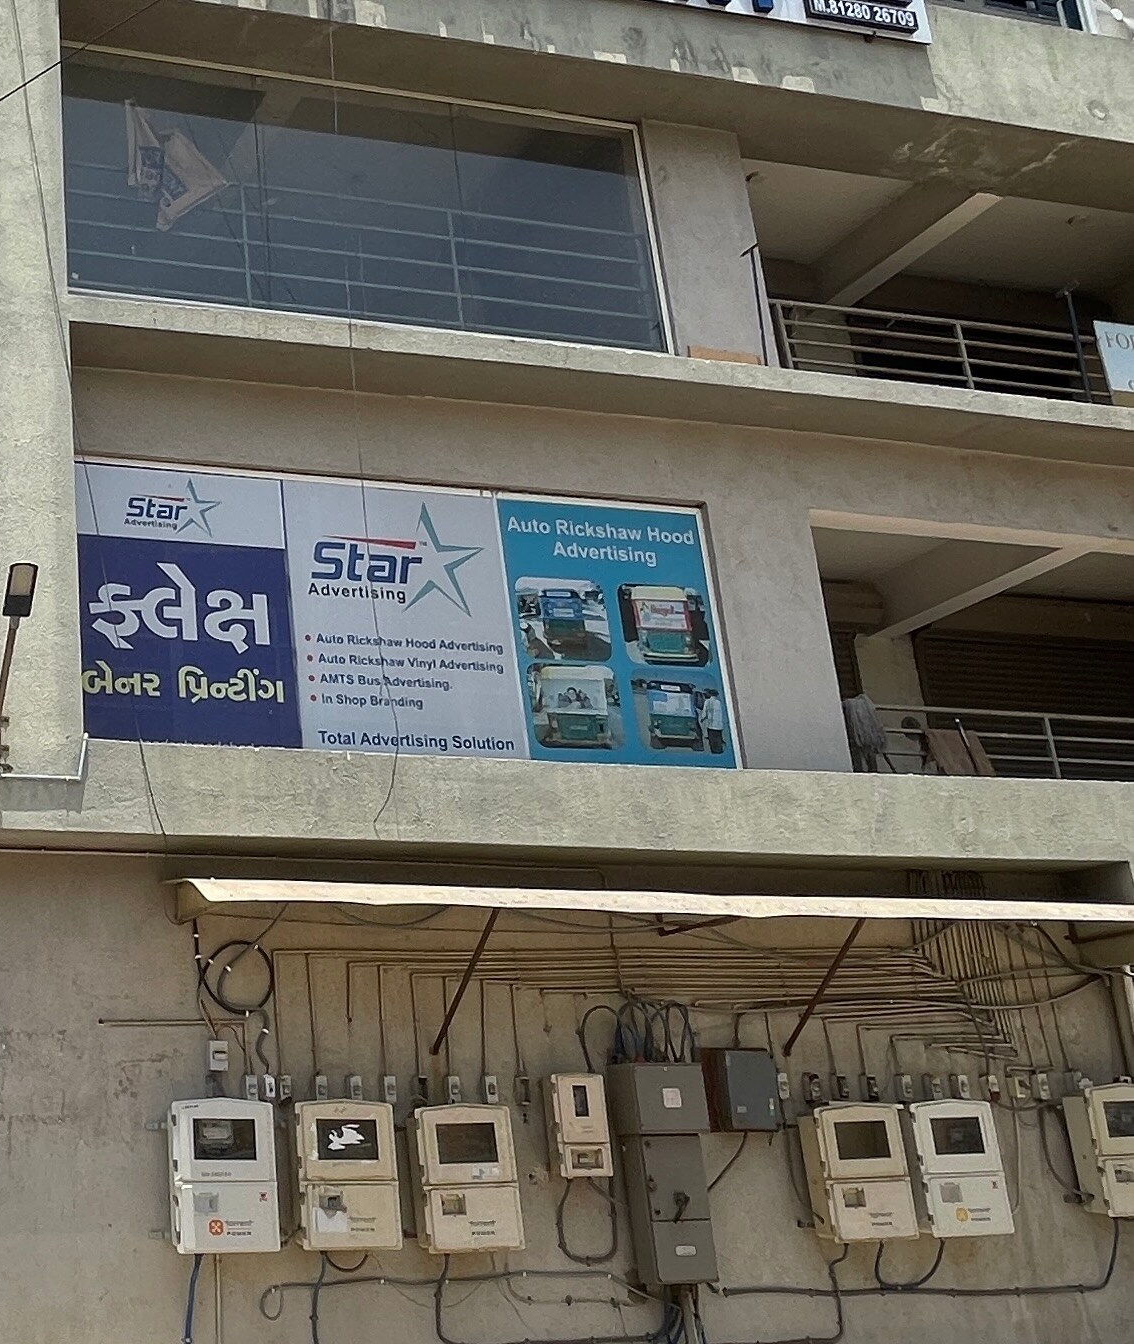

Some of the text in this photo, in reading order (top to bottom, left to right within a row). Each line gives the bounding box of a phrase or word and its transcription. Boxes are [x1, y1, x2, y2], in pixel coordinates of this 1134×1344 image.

[874, 7, 915, 26] 26709
[126, 496, 188, 521] Star
[507, 516, 696, 546] Auto Rickshaw Hood
[311, 540, 423, 584] Star
[552, 541, 657, 568] Advertising
[308, 582, 407, 605] Advertising
[316, 633, 504, 655] Auto Rickshaw Hood Advertising
[318, 653, 504, 674] Auto Rickshaw Vinyl Advertising
[81, 660, 160, 697] બેનર
[320, 674, 354, 685] AMTS
[358, 675, 381, 686] Bus
[322, 694, 423, 710] In Shop Branding
[318, 731, 515, 751] Total Advertising Solution
